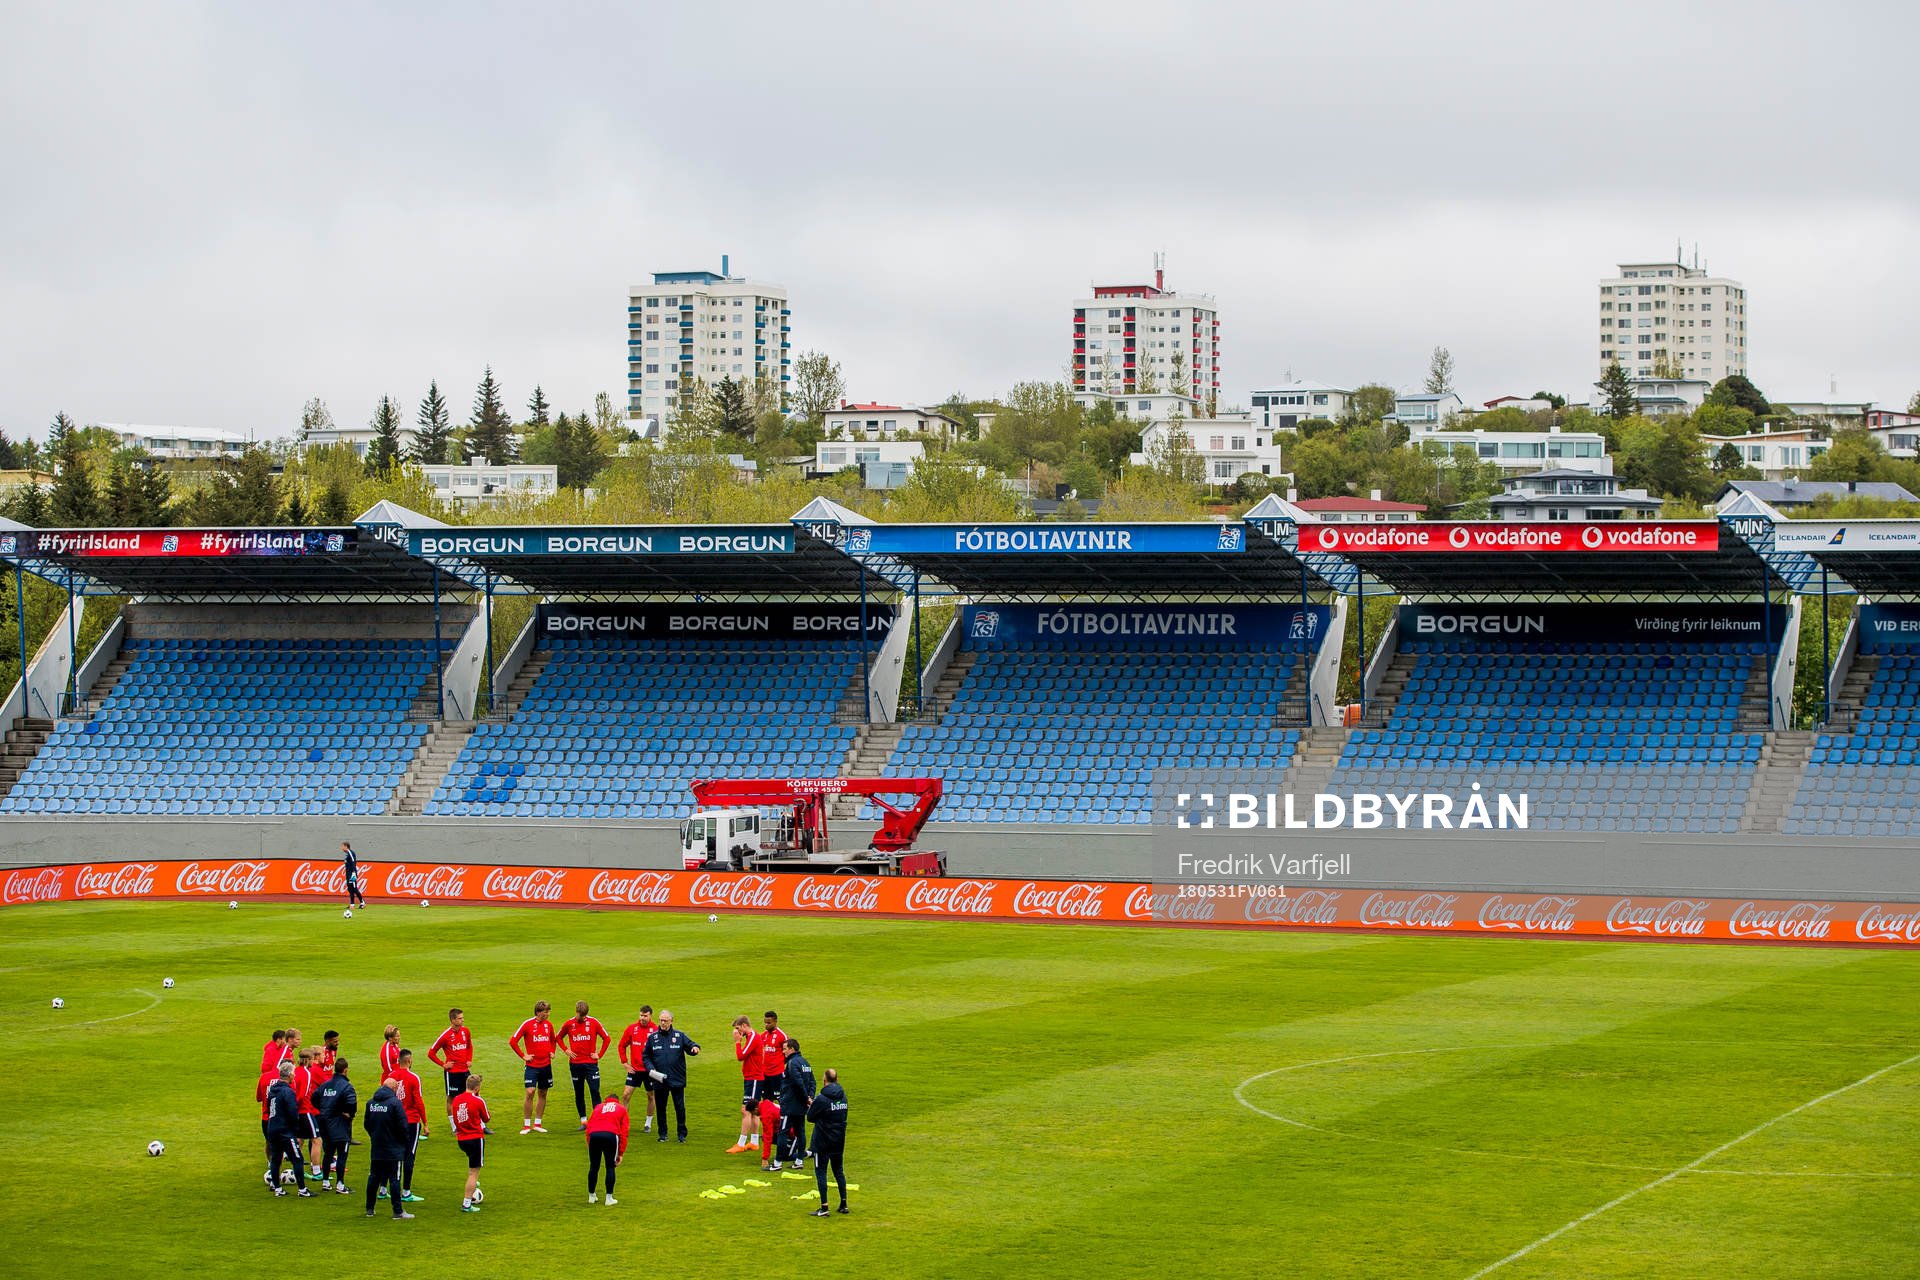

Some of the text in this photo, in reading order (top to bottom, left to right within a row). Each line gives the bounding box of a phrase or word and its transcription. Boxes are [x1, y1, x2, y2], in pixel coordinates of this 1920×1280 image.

[38, 534, 140, 554] #fyrirIsland
[200, 533, 304, 553] #fyrirIsland
[421, 537, 524, 553] BORGUN
[548, 536, 652, 552] BORGUN
[679, 536, 785, 551] BORGUN
[955, 527, 1132, 550] FÓTBOLTAVINIR
[1343, 528, 1429, 545] vodafone
[1474, 527, 1562, 545] vodafone
[1607, 527, 1697, 545] vodafone
[1778, 534, 1826, 542] ICELANDAIR
[1868, 533, 1916, 541] ICELANDAIR
[547, 616, 645, 631] BORGUN
[669, 616, 769, 631] BORGUN
[1037, 608, 1236, 635] FÓTBOLTAVINIR
[1416, 615, 1544, 633] BORGUN
[1635, 618, 1761, 633] Virðing fyrir leiknum
[1900, 620, 1920, 631] ER
[4, 868, 65, 903] Coca-Cola
[75, 864, 159, 896] Coca-Cola
[176, 862, 271, 894] Coca-Cola
[385, 865, 468, 897] Coca-Cola
[482, 867, 567, 900] Coca-Cola
[588, 871, 675, 904] Coca-Cola
[689, 873, 778, 907] Coca-Cola
[793, 876, 883, 910] Coca-Cola
[905, 879, 998, 913] Coca-Cola
[1013, 882, 1108, 917] Coca-Cola
[1245, 889, 1342, 924] Coca-Cola
[1360, 892, 1460, 928] Coca-Cola
[1478, 895, 1581, 931] Coca-Cola
[1606, 898, 1711, 935] Coca-Cola
[1729, 902, 1835, 938] Coca-Cola
